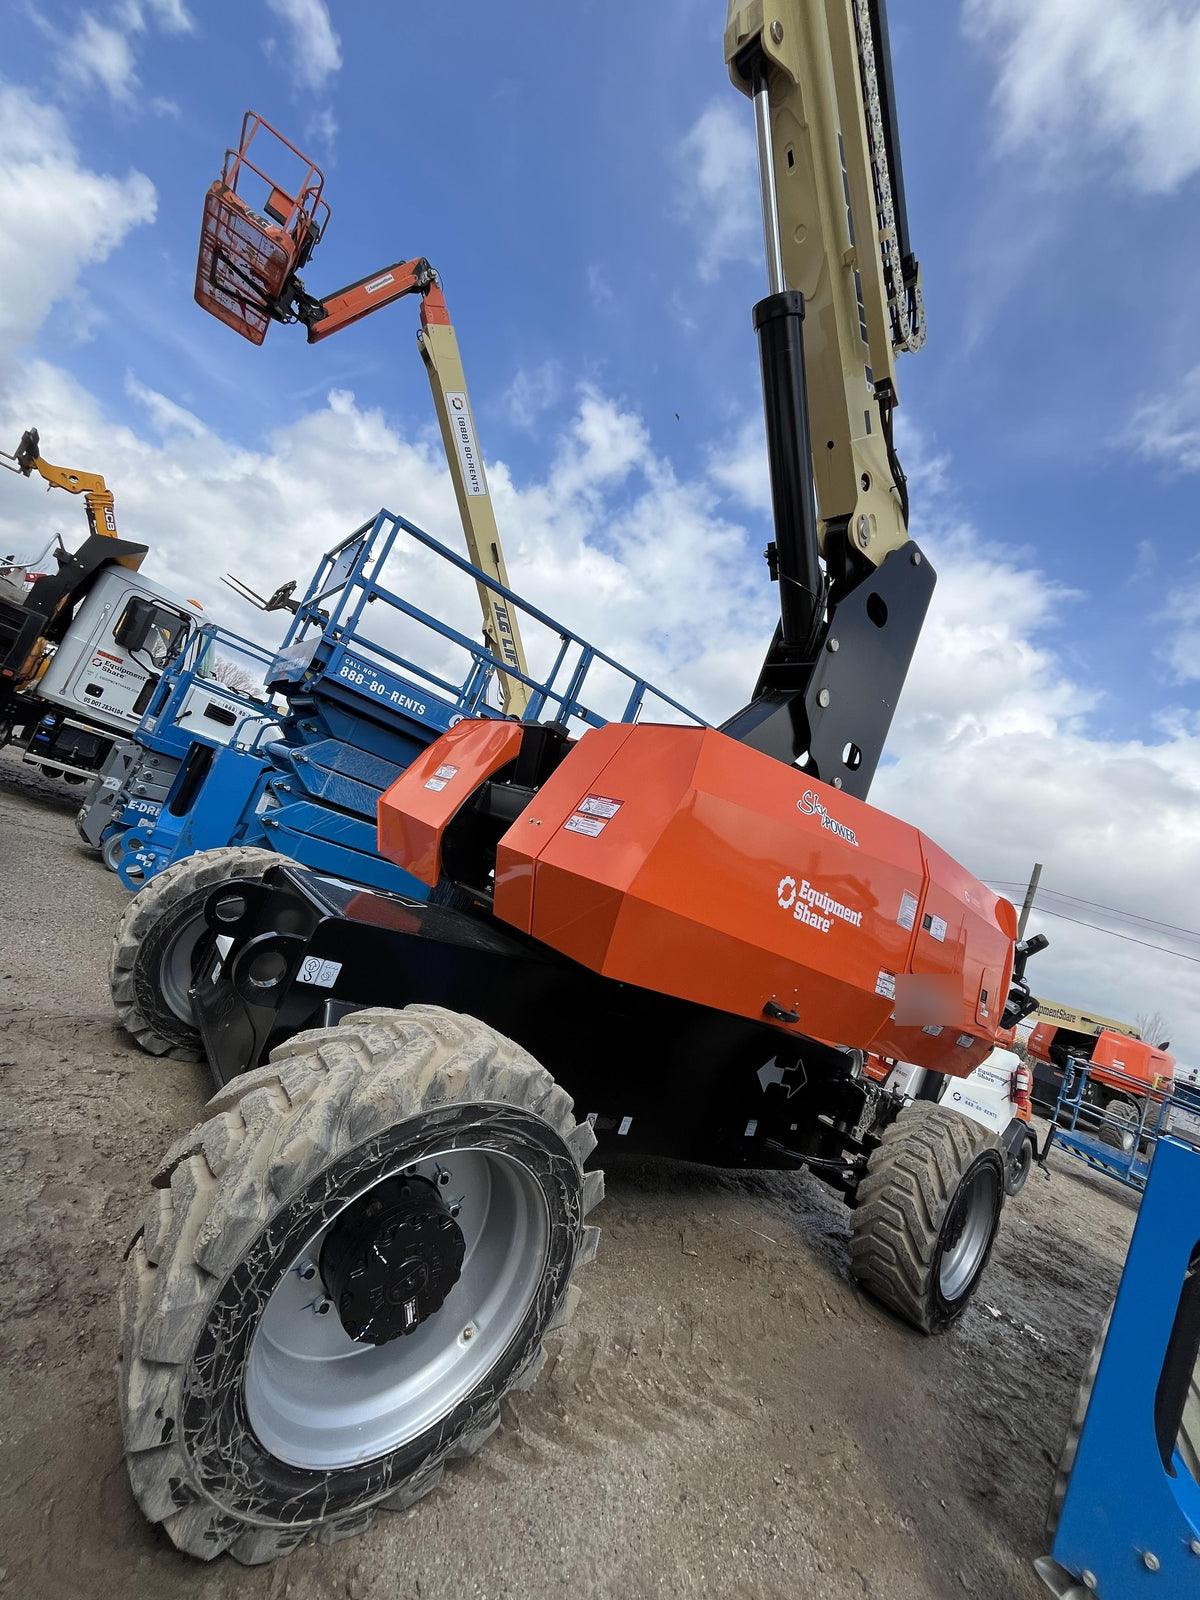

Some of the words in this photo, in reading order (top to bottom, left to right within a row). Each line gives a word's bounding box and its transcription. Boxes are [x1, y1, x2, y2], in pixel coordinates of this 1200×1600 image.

[457, 417, 469, 443] (888)
[464, 446, 480, 492] 80-RENTS
[104, 507, 115, 531] JCB
[493, 602, 510, 633] JLG
[101, 666, 125, 679] Share
[104, 660, 146, 681] Equipment
[344, 658, 361, 670] CALL
[362, 668, 378, 679] NOW
[340, 666, 426, 715] 888-80-RENTS
[91, 699, 102, 708] DOT
[127, 800, 161, 817] E-DRI
[798, 879, 863, 927] Equipment
